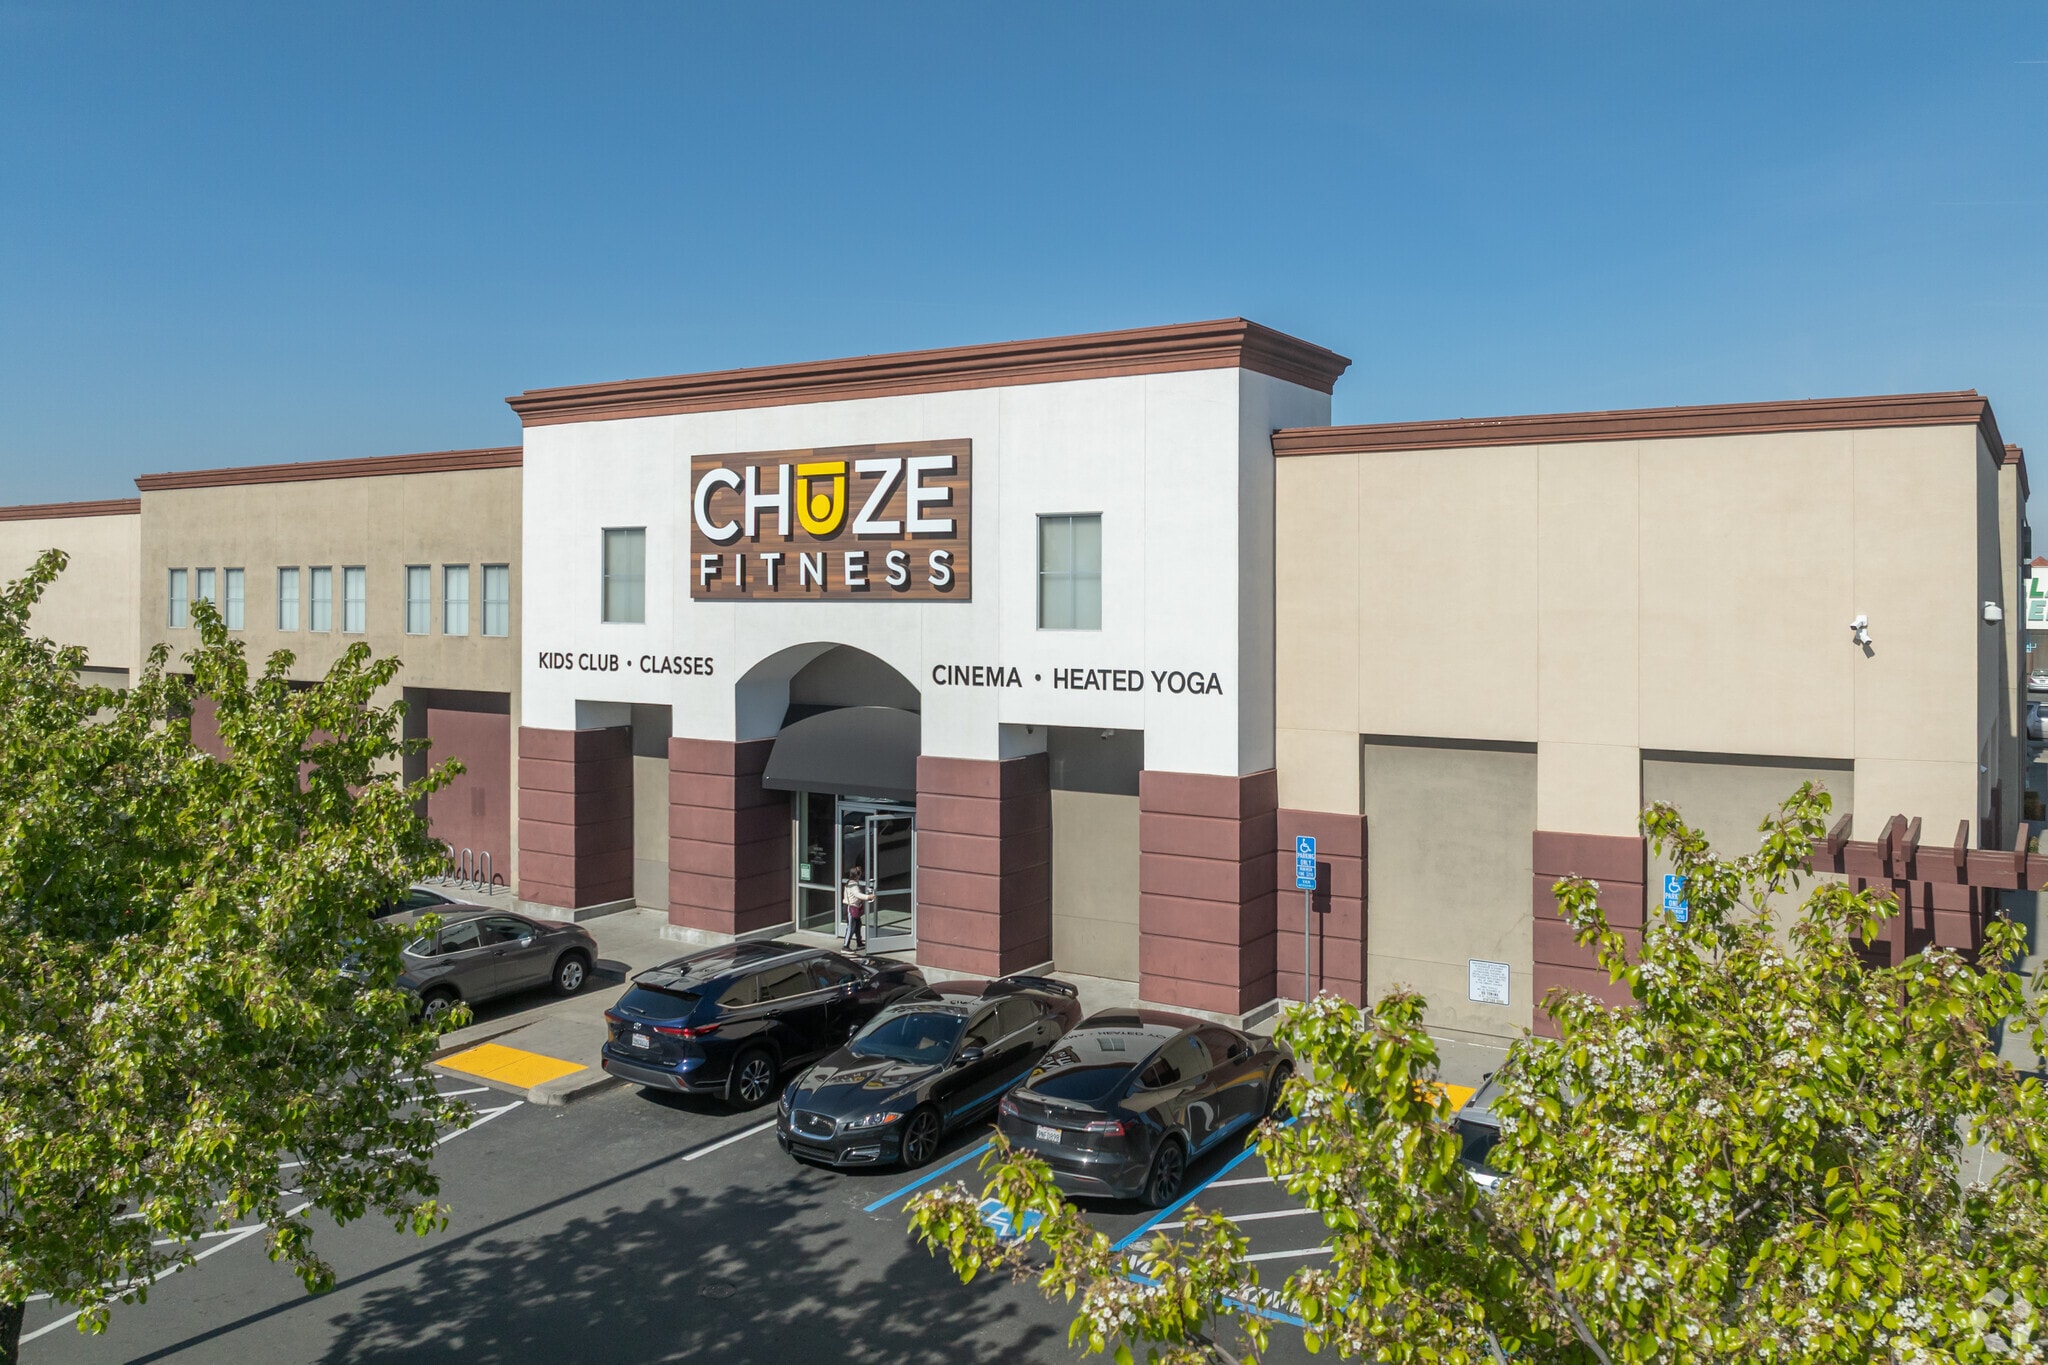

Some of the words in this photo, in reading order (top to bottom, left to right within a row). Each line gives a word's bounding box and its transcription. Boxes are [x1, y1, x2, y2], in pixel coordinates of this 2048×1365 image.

[694, 455, 953, 541] CHUZE
[701, 550, 951, 586] FITNESS
[539, 652, 573, 670] KIDS
[578, 653, 619, 671] CLUB
[640, 655, 714, 675] CLASSES
[932, 664, 1022, 688] CINEMA
[1053, 668, 1144, 691] HEATED
[1151, 671, 1223, 695] YOGA
[1300, 859, 1311, 867] ONLY
